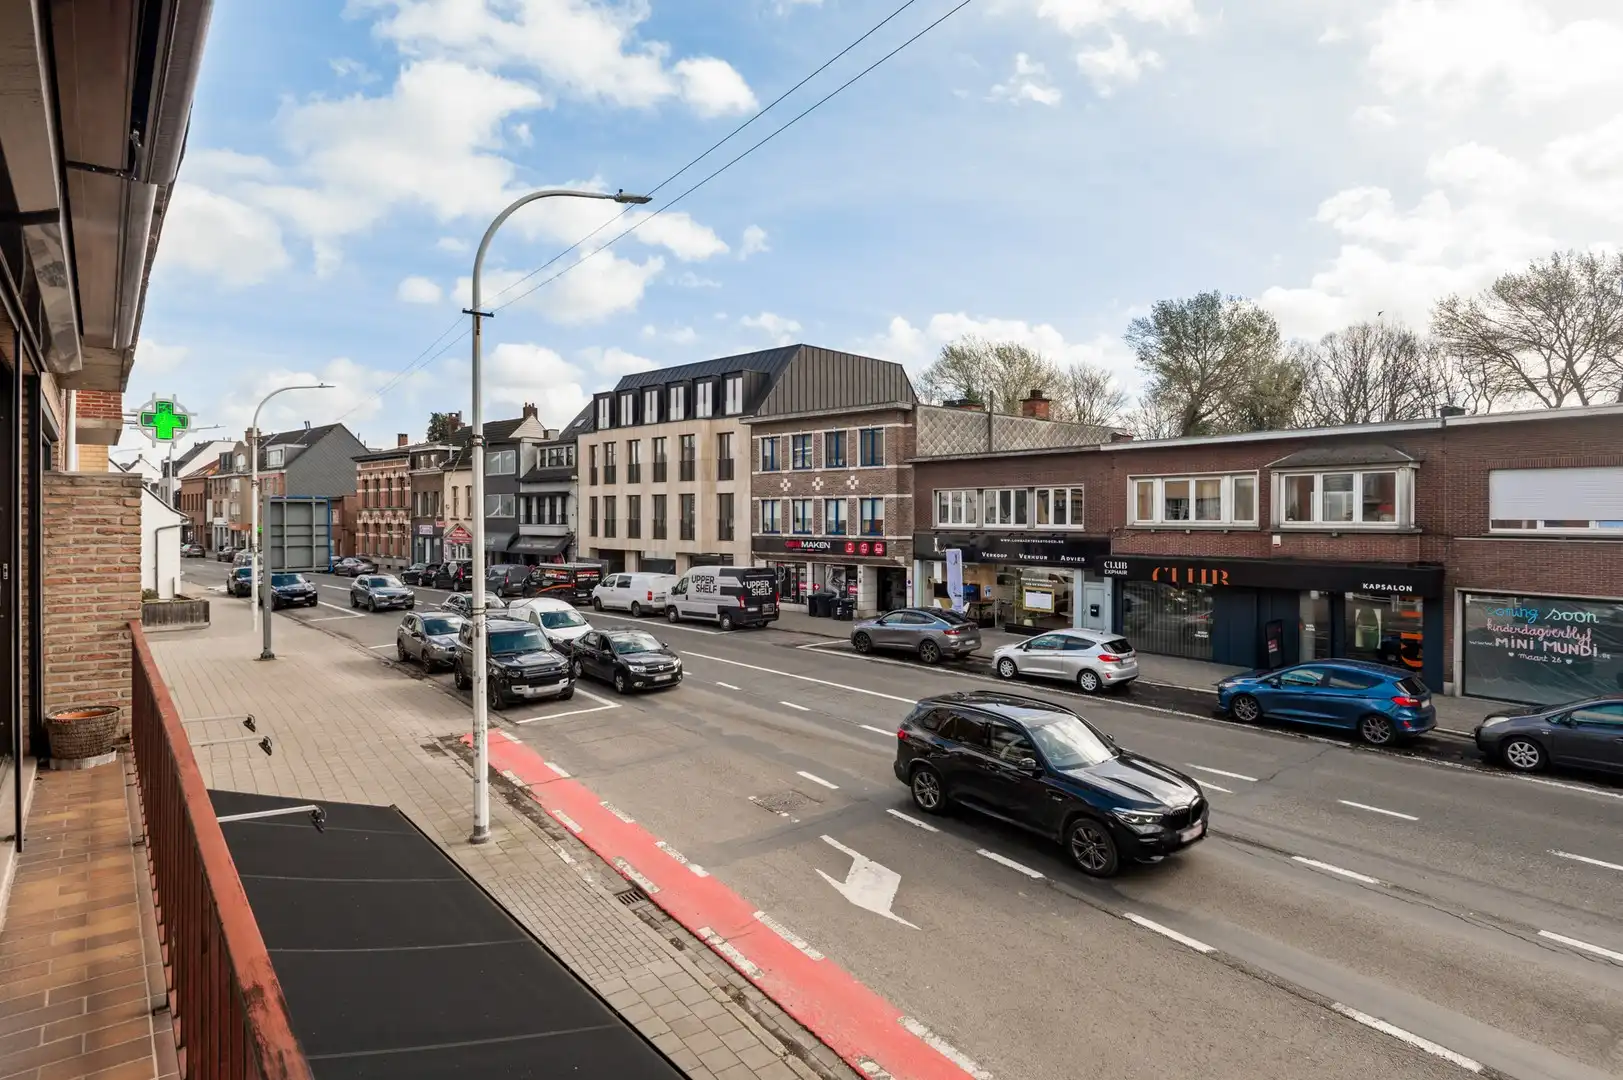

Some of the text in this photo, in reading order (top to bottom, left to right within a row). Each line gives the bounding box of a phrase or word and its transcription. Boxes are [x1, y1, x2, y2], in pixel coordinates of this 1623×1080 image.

[1104, 561, 1128, 569] CLUB
[691, 575, 714, 584] UPPER
[746, 580, 769, 588] UPPER
[696, 584, 717, 593] SHELF
[751, 587, 772, 596] SHELF
[1362, 583, 1412, 591] KAPSALON
[1544, 608, 1600, 623] soon
